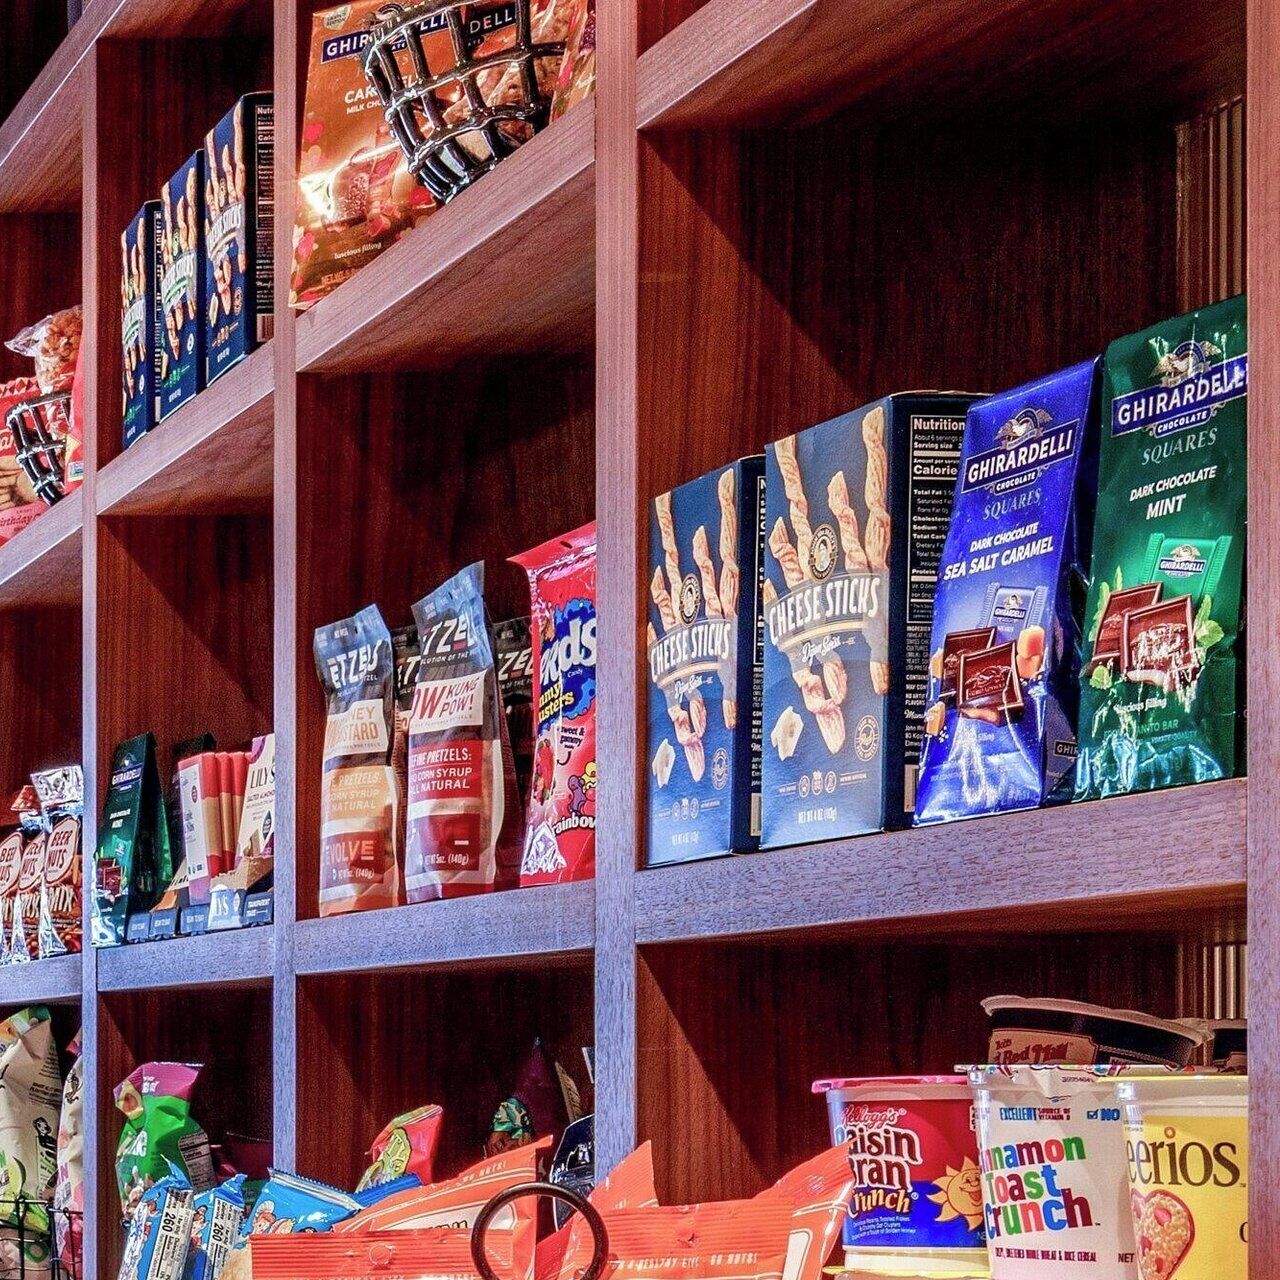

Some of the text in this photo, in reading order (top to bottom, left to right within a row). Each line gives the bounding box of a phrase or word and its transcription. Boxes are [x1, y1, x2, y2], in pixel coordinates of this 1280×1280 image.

[334, 242, 382, 259] luscious filling
[968, 430, 1073, 483] GHIRARDELLI
[1146, 494, 1187, 520] MINT
[944, 536, 1054, 580] SEA SALT CARAMEL
[769, 578, 881, 645] CHEESE STICKS
[651, 623, 731, 681] CHEESE STICKS
[447, 676, 480, 696] KUNG
[442, 694, 473, 718] POW!
[427, 748, 472, 763] PRETZELS:
[51, 831, 72, 846] BEER
[48, 850, 66, 869] NUTS
[50, 885, 74, 912] MIX
[842, 1105, 899, 1132] Kellogg's
[1000, 1107, 1037, 1122] EXCELLENT
[1100, 1109, 1121, 1122] NO
[849, 1126, 920, 1160] aisin
[162, 1210, 175, 1233] 260
[985, 1189, 1093, 1239] Crunch
[213, 1223, 224, 1243] 260
